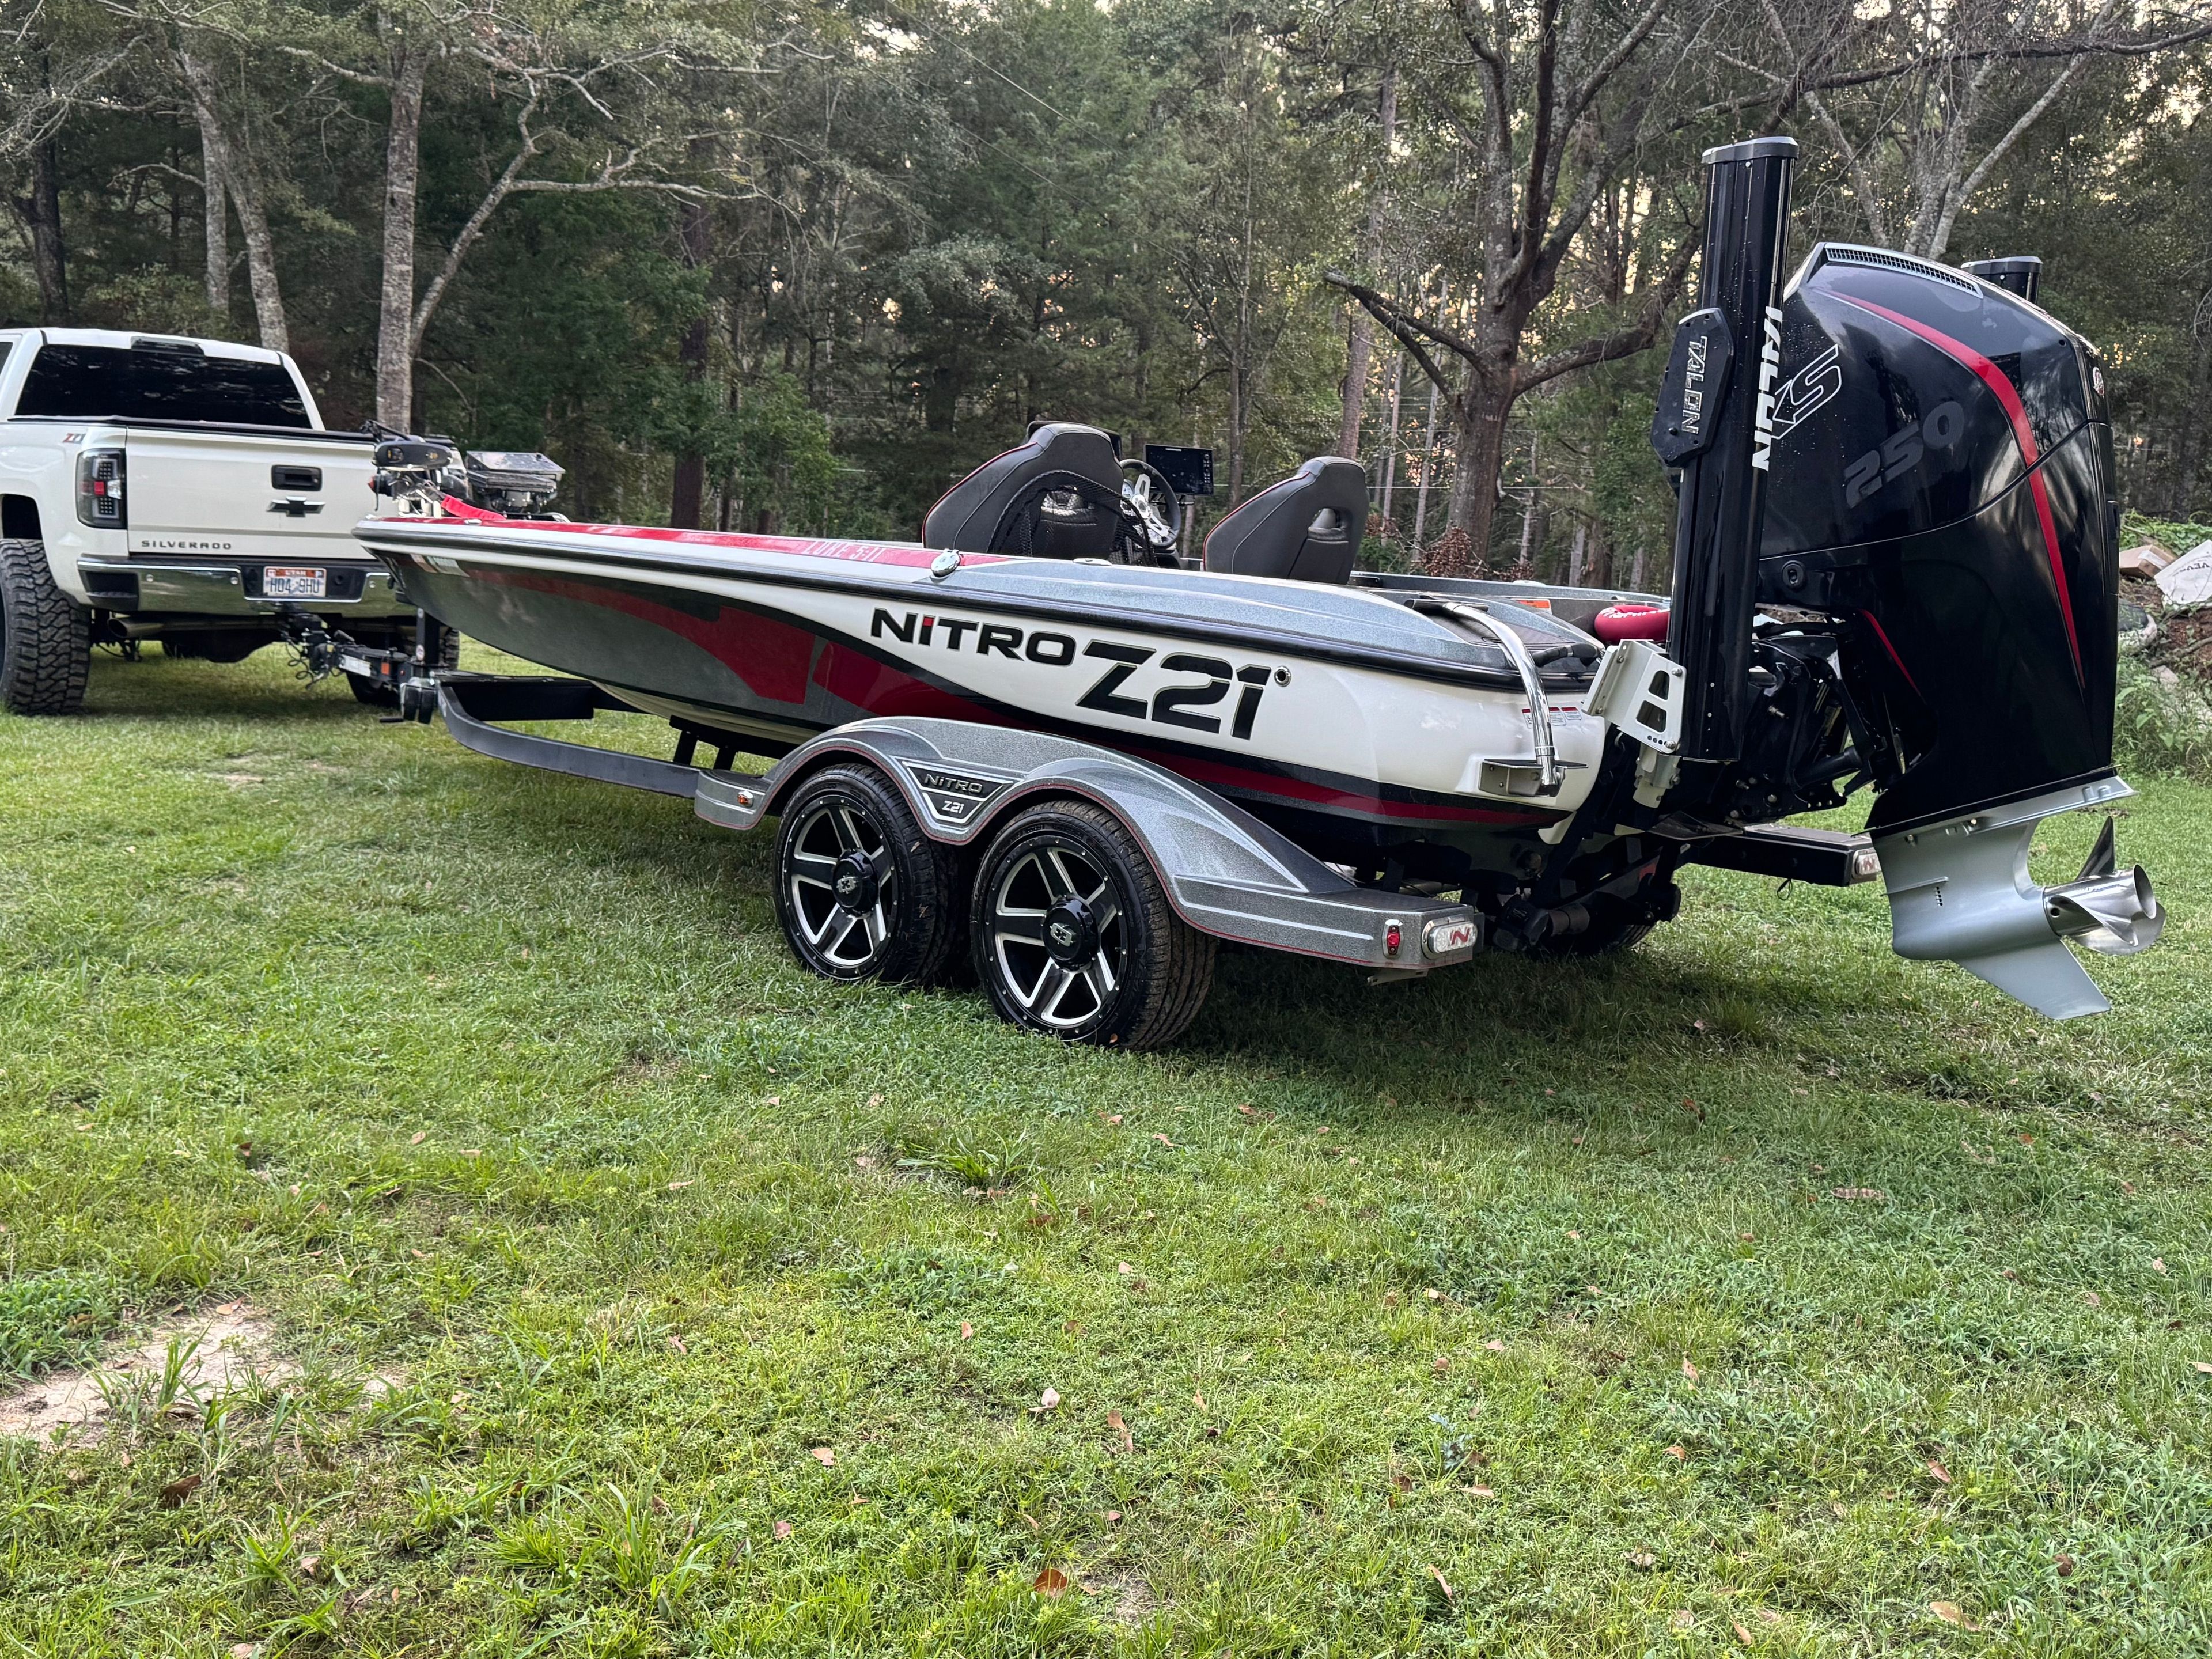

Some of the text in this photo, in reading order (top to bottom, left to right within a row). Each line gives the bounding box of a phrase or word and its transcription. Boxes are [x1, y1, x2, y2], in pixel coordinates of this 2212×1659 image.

[1681, 335, 1708, 434] TALON
[1844, 400, 1965, 509] 250
[141, 540, 232, 550] SILVERADO
[801, 540, 887, 562] LUKE 5:11
[1075, 639, 1272, 741] Z21
[941, 800, 964, 814] Z21
